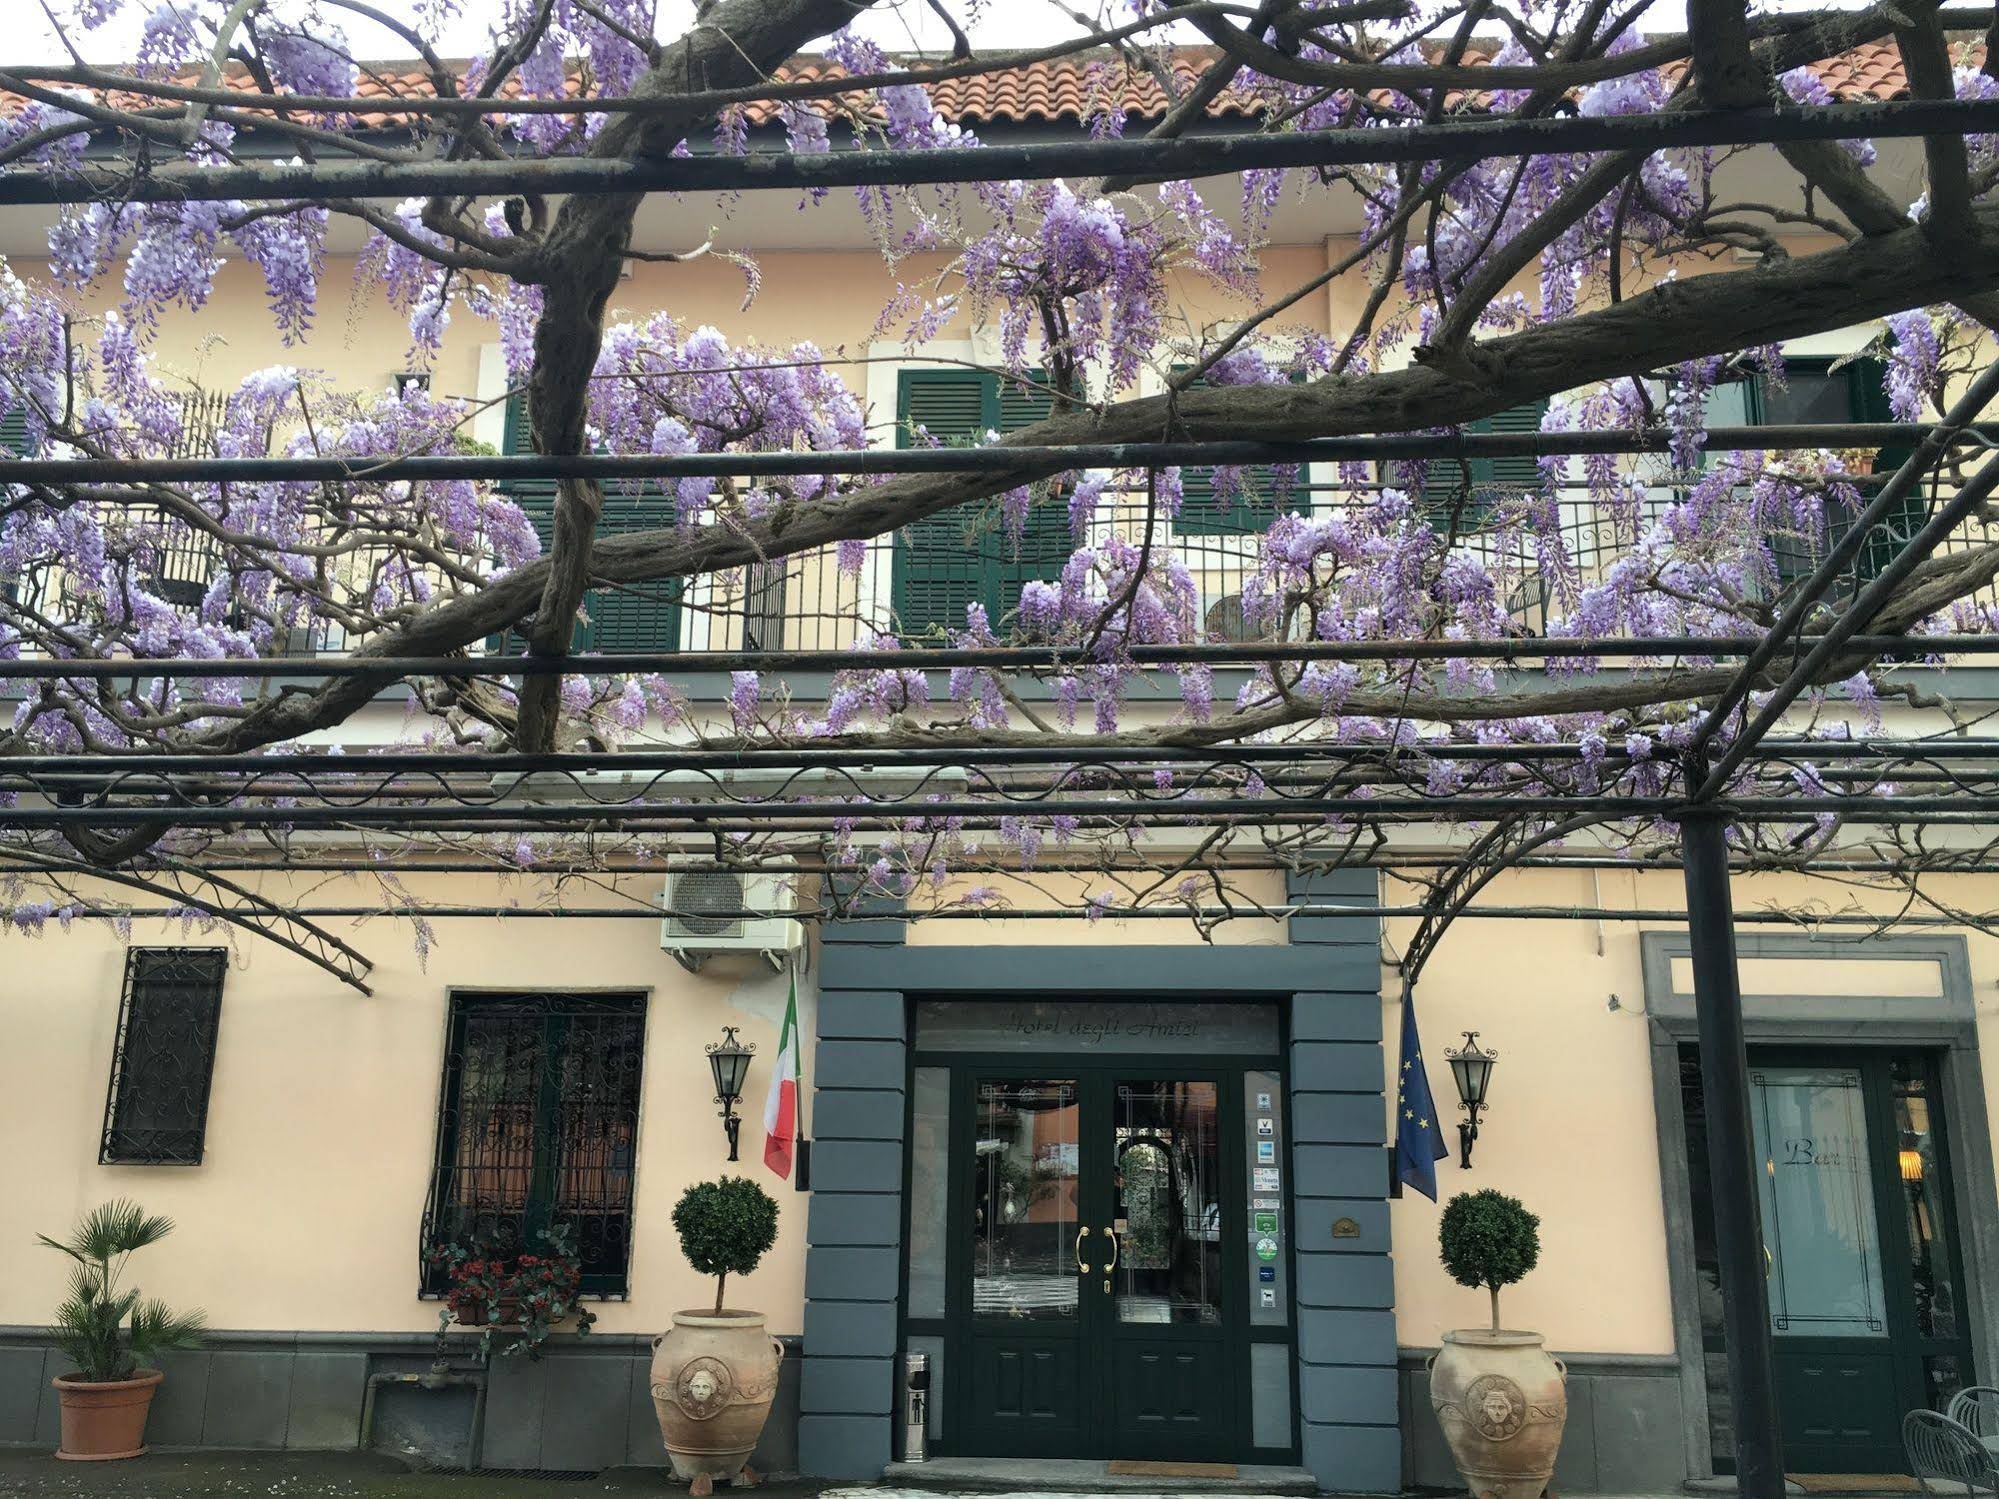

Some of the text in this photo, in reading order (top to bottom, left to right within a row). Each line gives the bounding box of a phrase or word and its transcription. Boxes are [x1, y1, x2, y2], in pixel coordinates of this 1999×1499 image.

[1001, 1013, 1062, 1034] Hotel
[1070, 1016, 1120, 1043] degli
[1783, 1137, 1841, 1165] Bar
